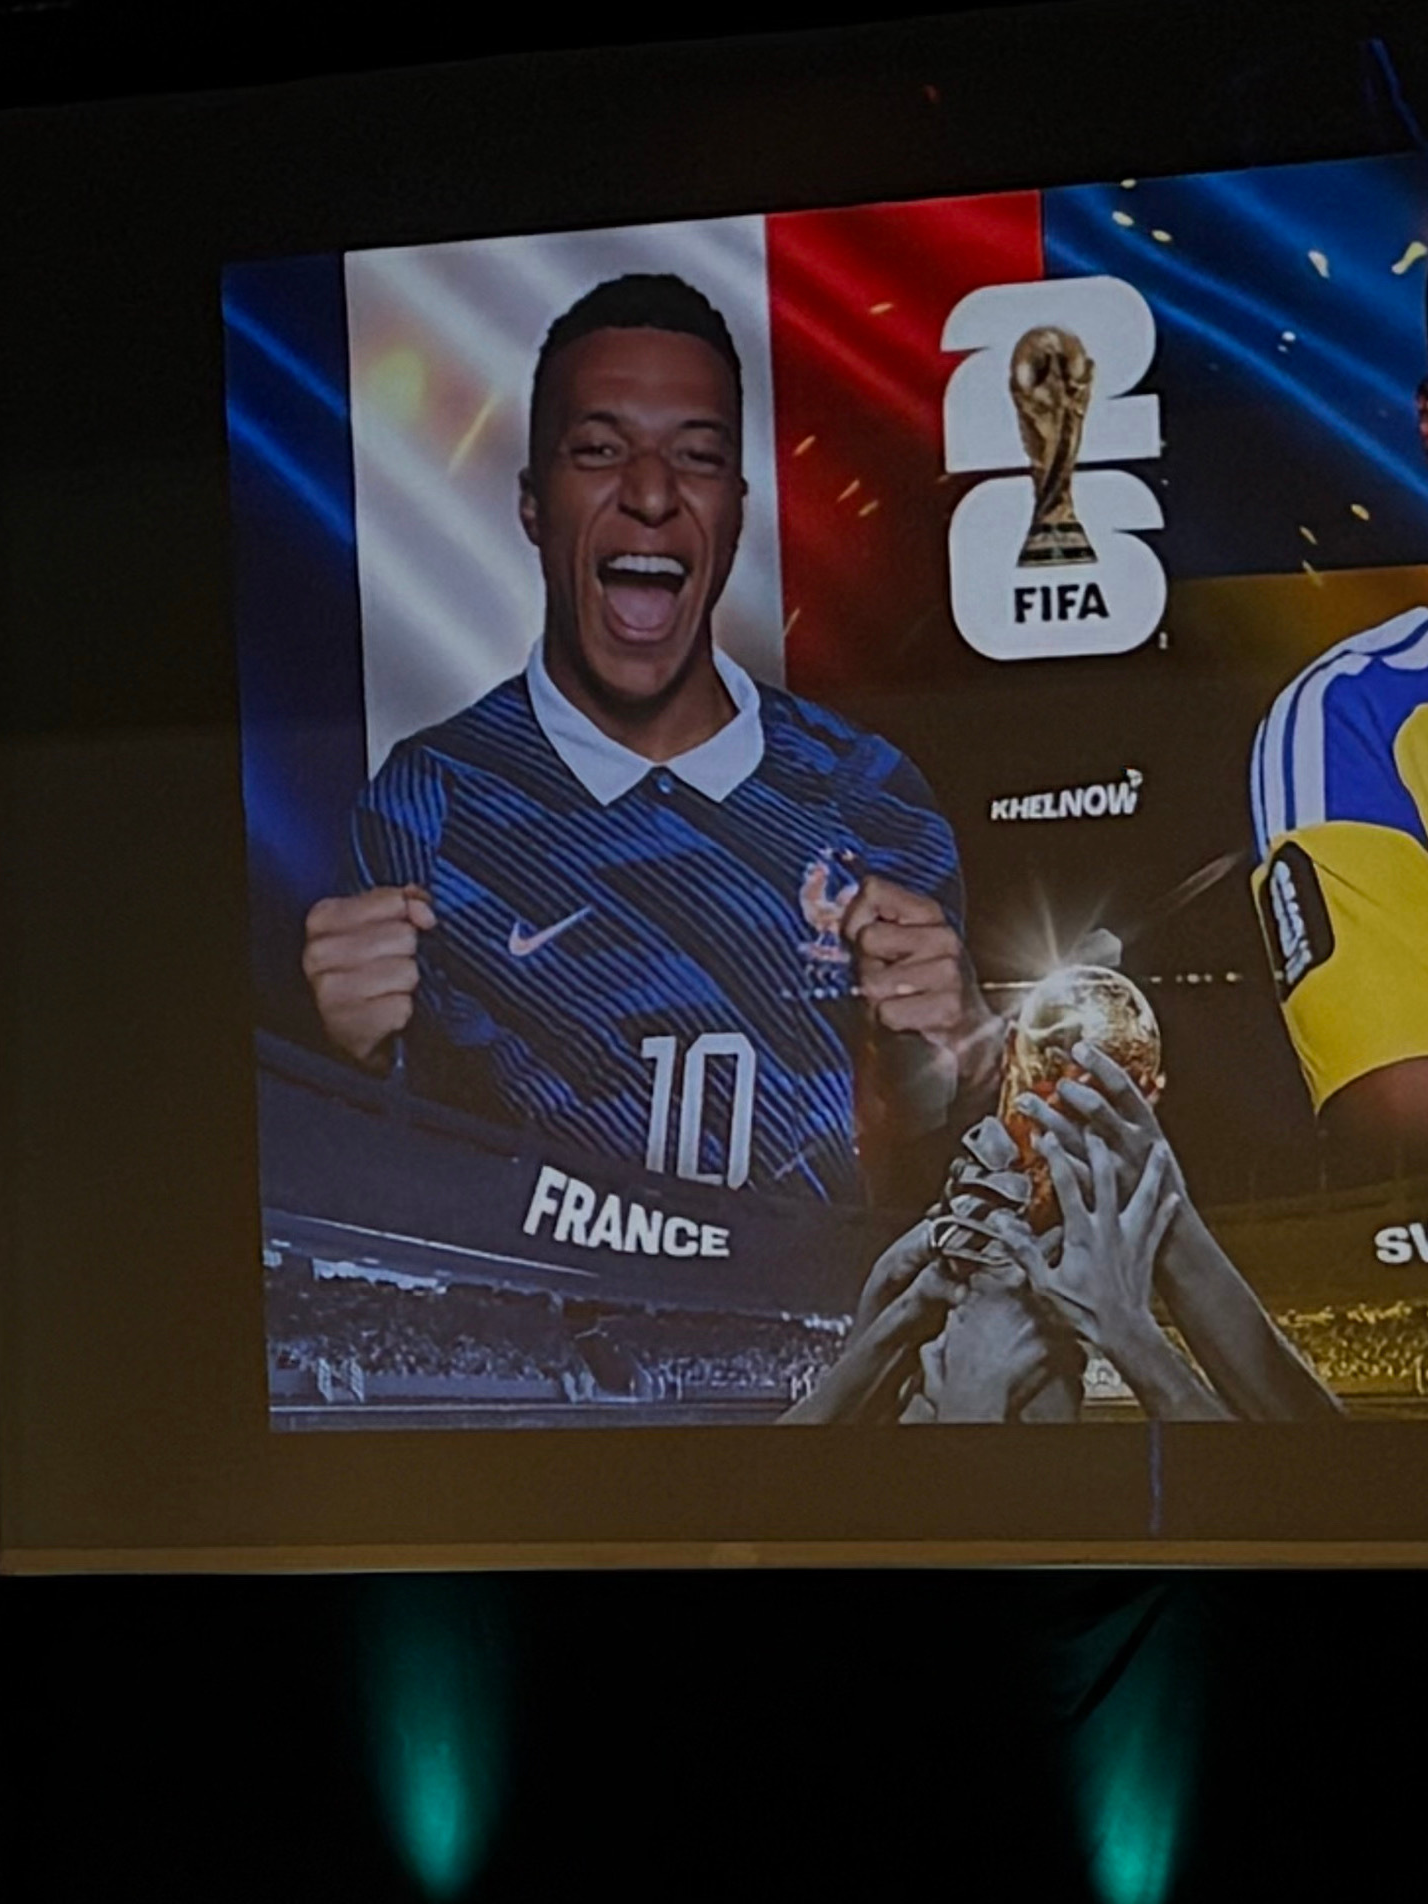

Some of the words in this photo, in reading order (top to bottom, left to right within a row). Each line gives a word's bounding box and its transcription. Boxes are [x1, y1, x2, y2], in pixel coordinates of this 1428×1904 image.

[1014, 583, 1110, 624] FIFA
[641, 1032, 756, 1191] 10
[523, 1165, 730, 1257] FRANCE
